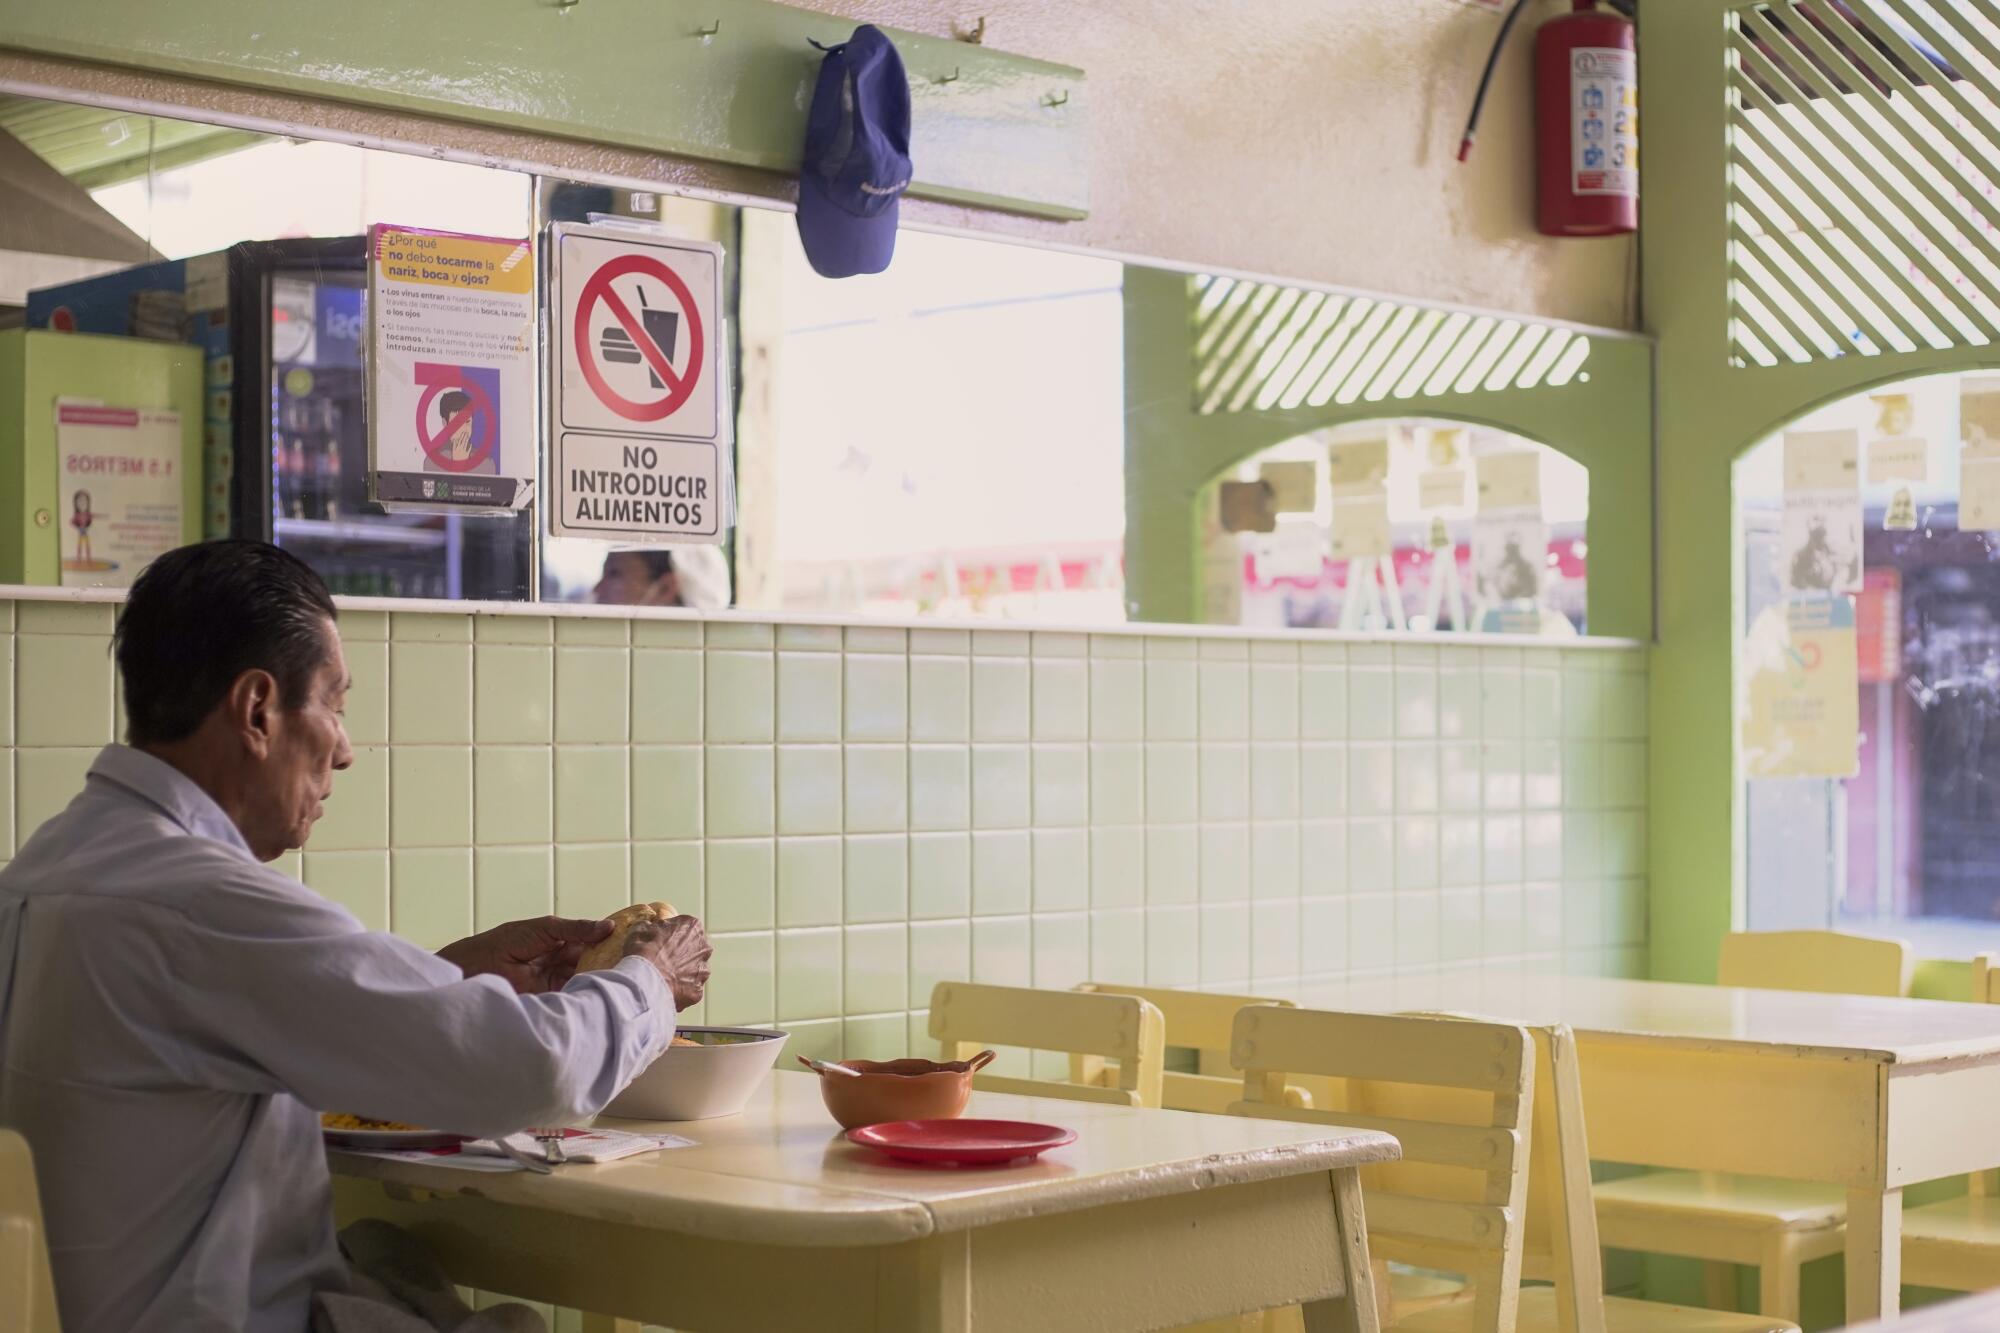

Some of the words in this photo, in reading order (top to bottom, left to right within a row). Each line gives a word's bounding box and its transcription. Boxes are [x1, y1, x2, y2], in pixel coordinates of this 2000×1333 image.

[388, 235, 413, 247] ¿Por
[416, 238, 437, 249] qué
[389, 251, 403, 260] no
[406, 252, 434, 264] debo
[436, 255, 483, 269] tocarme
[486, 260, 495, 271] la
[388, 264, 420, 278] nariz,
[422, 268, 449, 281] boca
[451, 274, 458, 284] y
[461, 274, 490, 285] ojos?
[386, 288, 399, 296] Los
[401, 289, 419, 298] virus
[421, 292, 445, 300] entran
[393, 308, 404, 316] los
[386, 342, 437, 354] introduzcan
[623, 445, 658, 470] NO
[571, 469, 707, 499] INTRODUCIR
[576, 497, 702, 526] ALIMENTOS
